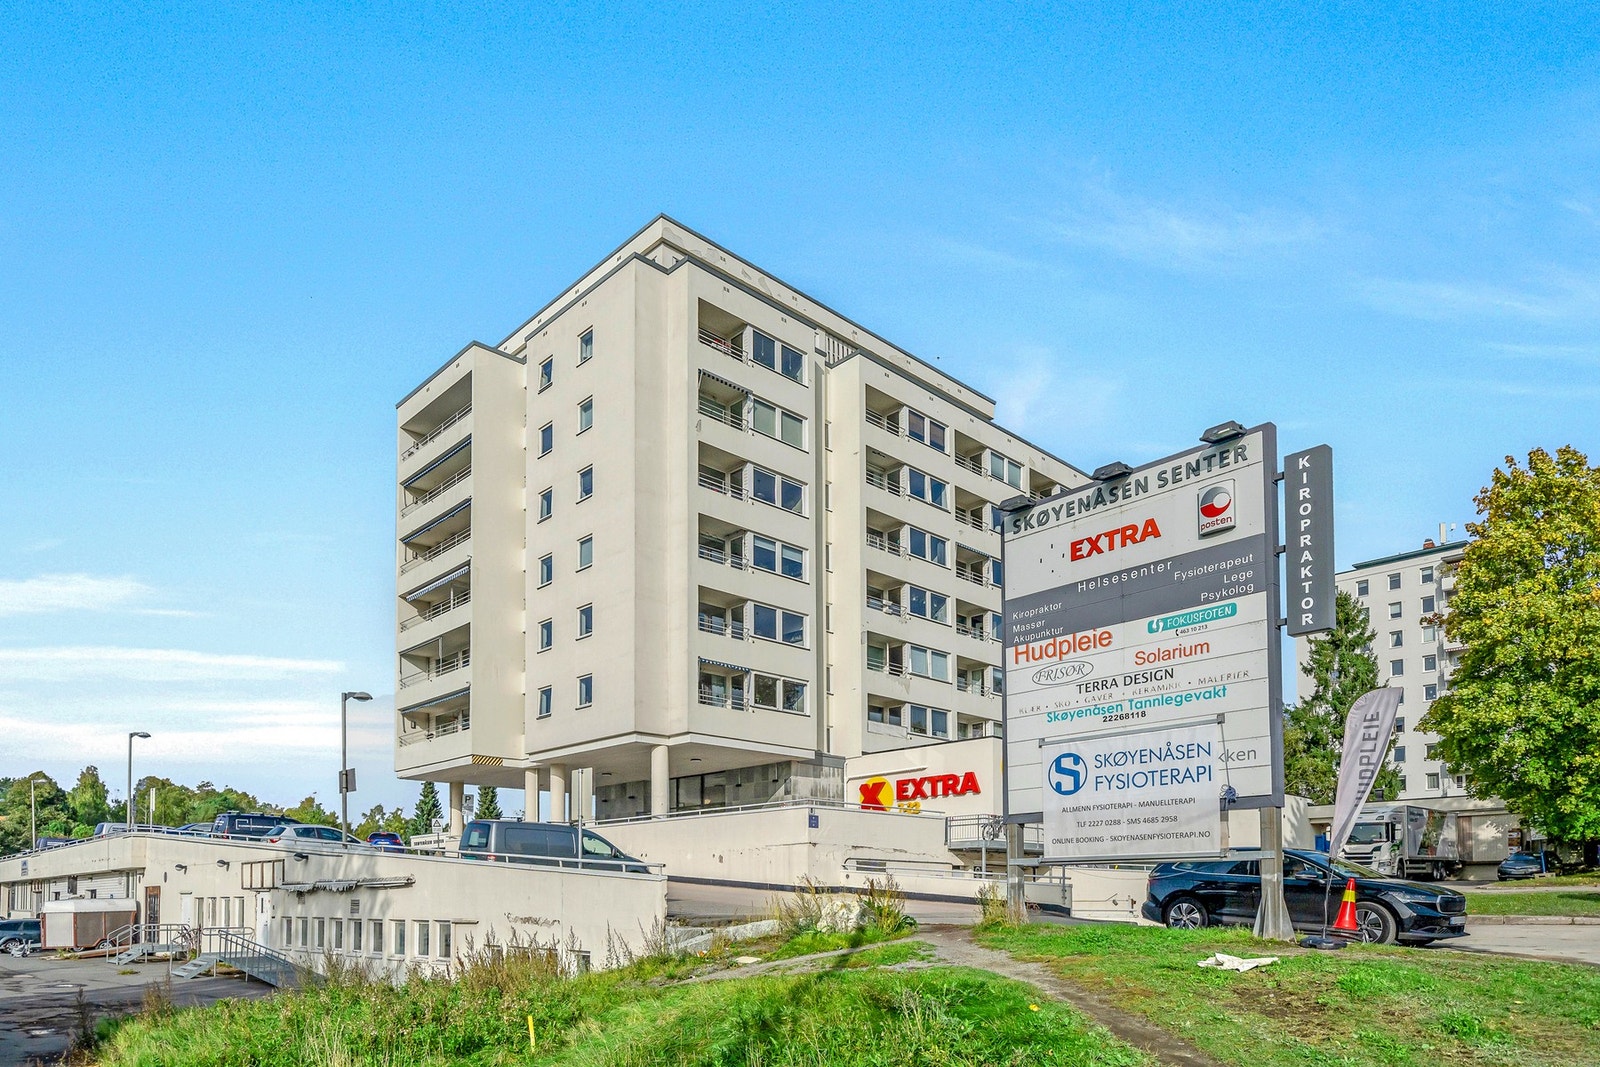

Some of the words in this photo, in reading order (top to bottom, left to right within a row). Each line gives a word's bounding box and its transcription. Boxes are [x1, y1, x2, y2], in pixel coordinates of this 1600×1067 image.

[1012, 476, 1149, 535] SKØYENÅSEN
[1157, 444, 1248, 489] SENTER
[1200, 516, 1233, 532] posten
[1070, 518, 1161, 562] EXTRA
[1298, 455, 1314, 626] KIROPRAKTOR
[1077, 560, 1173, 593] Helsesenter
[1174, 553, 1254, 581] Fysioterapeut
[1223, 570, 1254, 584] Lege
[1200, 583, 1254, 602] Psykolog
[1012, 602, 1062, 620] Kiropraktor
[1167, 605, 1232, 628] FOKUSFOTEN
[1012, 619, 1046, 634] Massør
[1013, 626, 1064, 644] Akupunktur
[1014, 628, 1113, 665] Hudpleie
[1134, 641, 1211, 666] Solarium
[1075, 678, 1119, 695] TERRA
[1123, 667, 1174, 687] DESIGN
[1046, 704, 1123, 723] Skøyenåsen
[1128, 685, 1227, 711] Tannlegevakt
[1102, 710, 1147, 723] 22268118
[1094, 741, 1212, 769] SKØYENÅSEN
[896, 772, 981, 801] EXTRA
[1095, 765, 1212, 791] FYSIOTERAPI
[1061, 805, 1092, 814] ALLMENN
[1092, 802, 1133, 812] FYSIOTERAPI
[1138, 797, 1196, 808] MANUELLTERAPI
[1105, 818, 1122, 826] 0288
[1126, 817, 1141, 825] SMS
[1142, 816, 1159, 824] 4685
[1160, 815, 1178, 823] 2958
[1051, 837, 1075, 845] ONLINE
[1076, 835, 1105, 844] BOOKING
